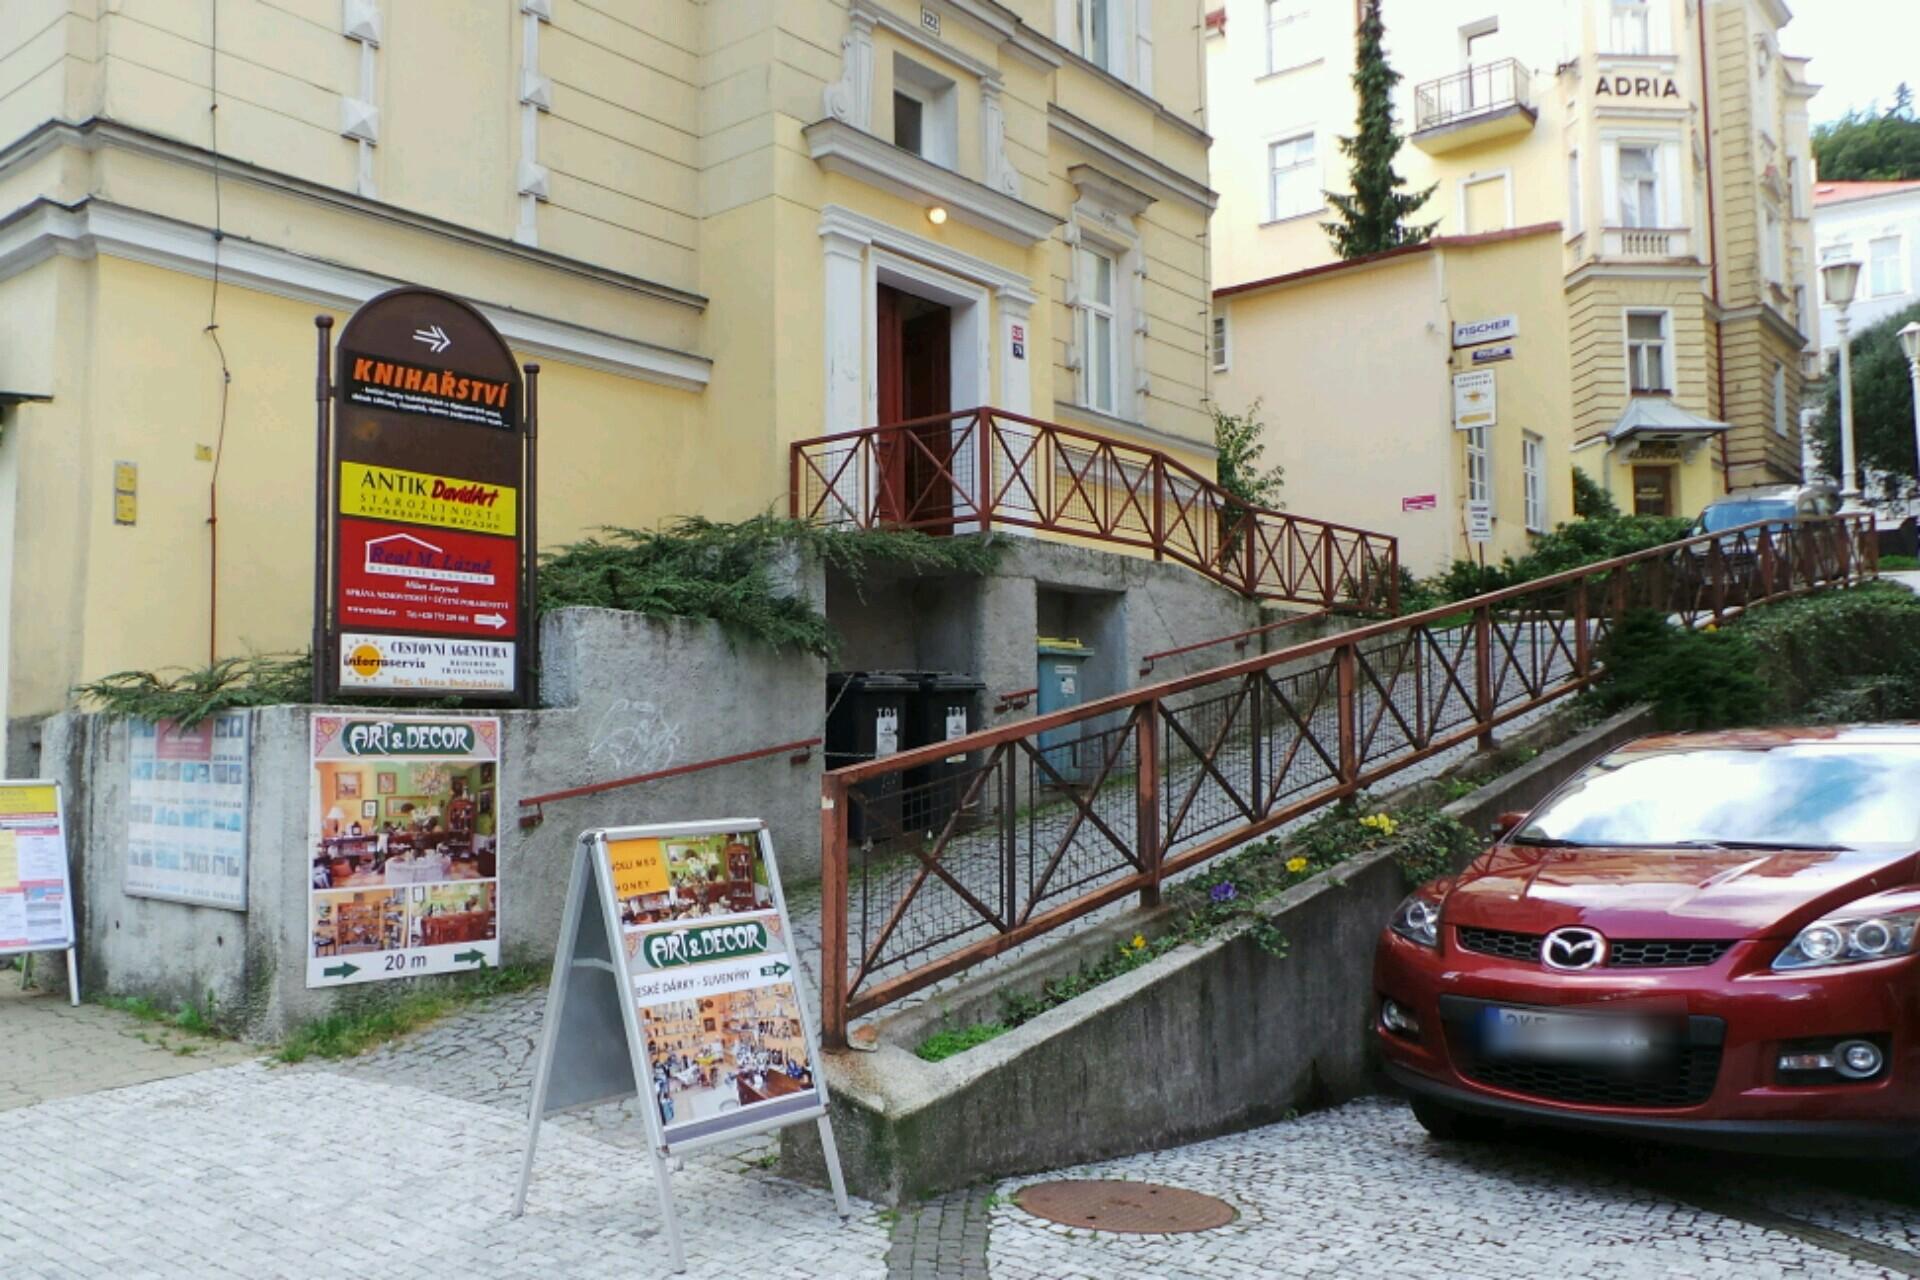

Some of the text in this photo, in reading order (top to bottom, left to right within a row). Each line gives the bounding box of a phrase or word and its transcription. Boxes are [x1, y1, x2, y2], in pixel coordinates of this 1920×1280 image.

[1595, 76, 1680, 98] ADRIA
[1458, 319, 1511, 336] FISCHER
[354, 358, 510, 408] KNIHAŘSTVÍ
[361, 470, 500, 507] ANTIK DavidArt
[360, 493, 501, 522] STAROŽITNOSTI
[390, 641, 508, 658] CESTOVNÍ AGENTURA
[351, 721, 474, 756] ART & DECOR
[651, 924, 764, 968] ART & DECOR
[384, 954, 427, 972] 20 m
